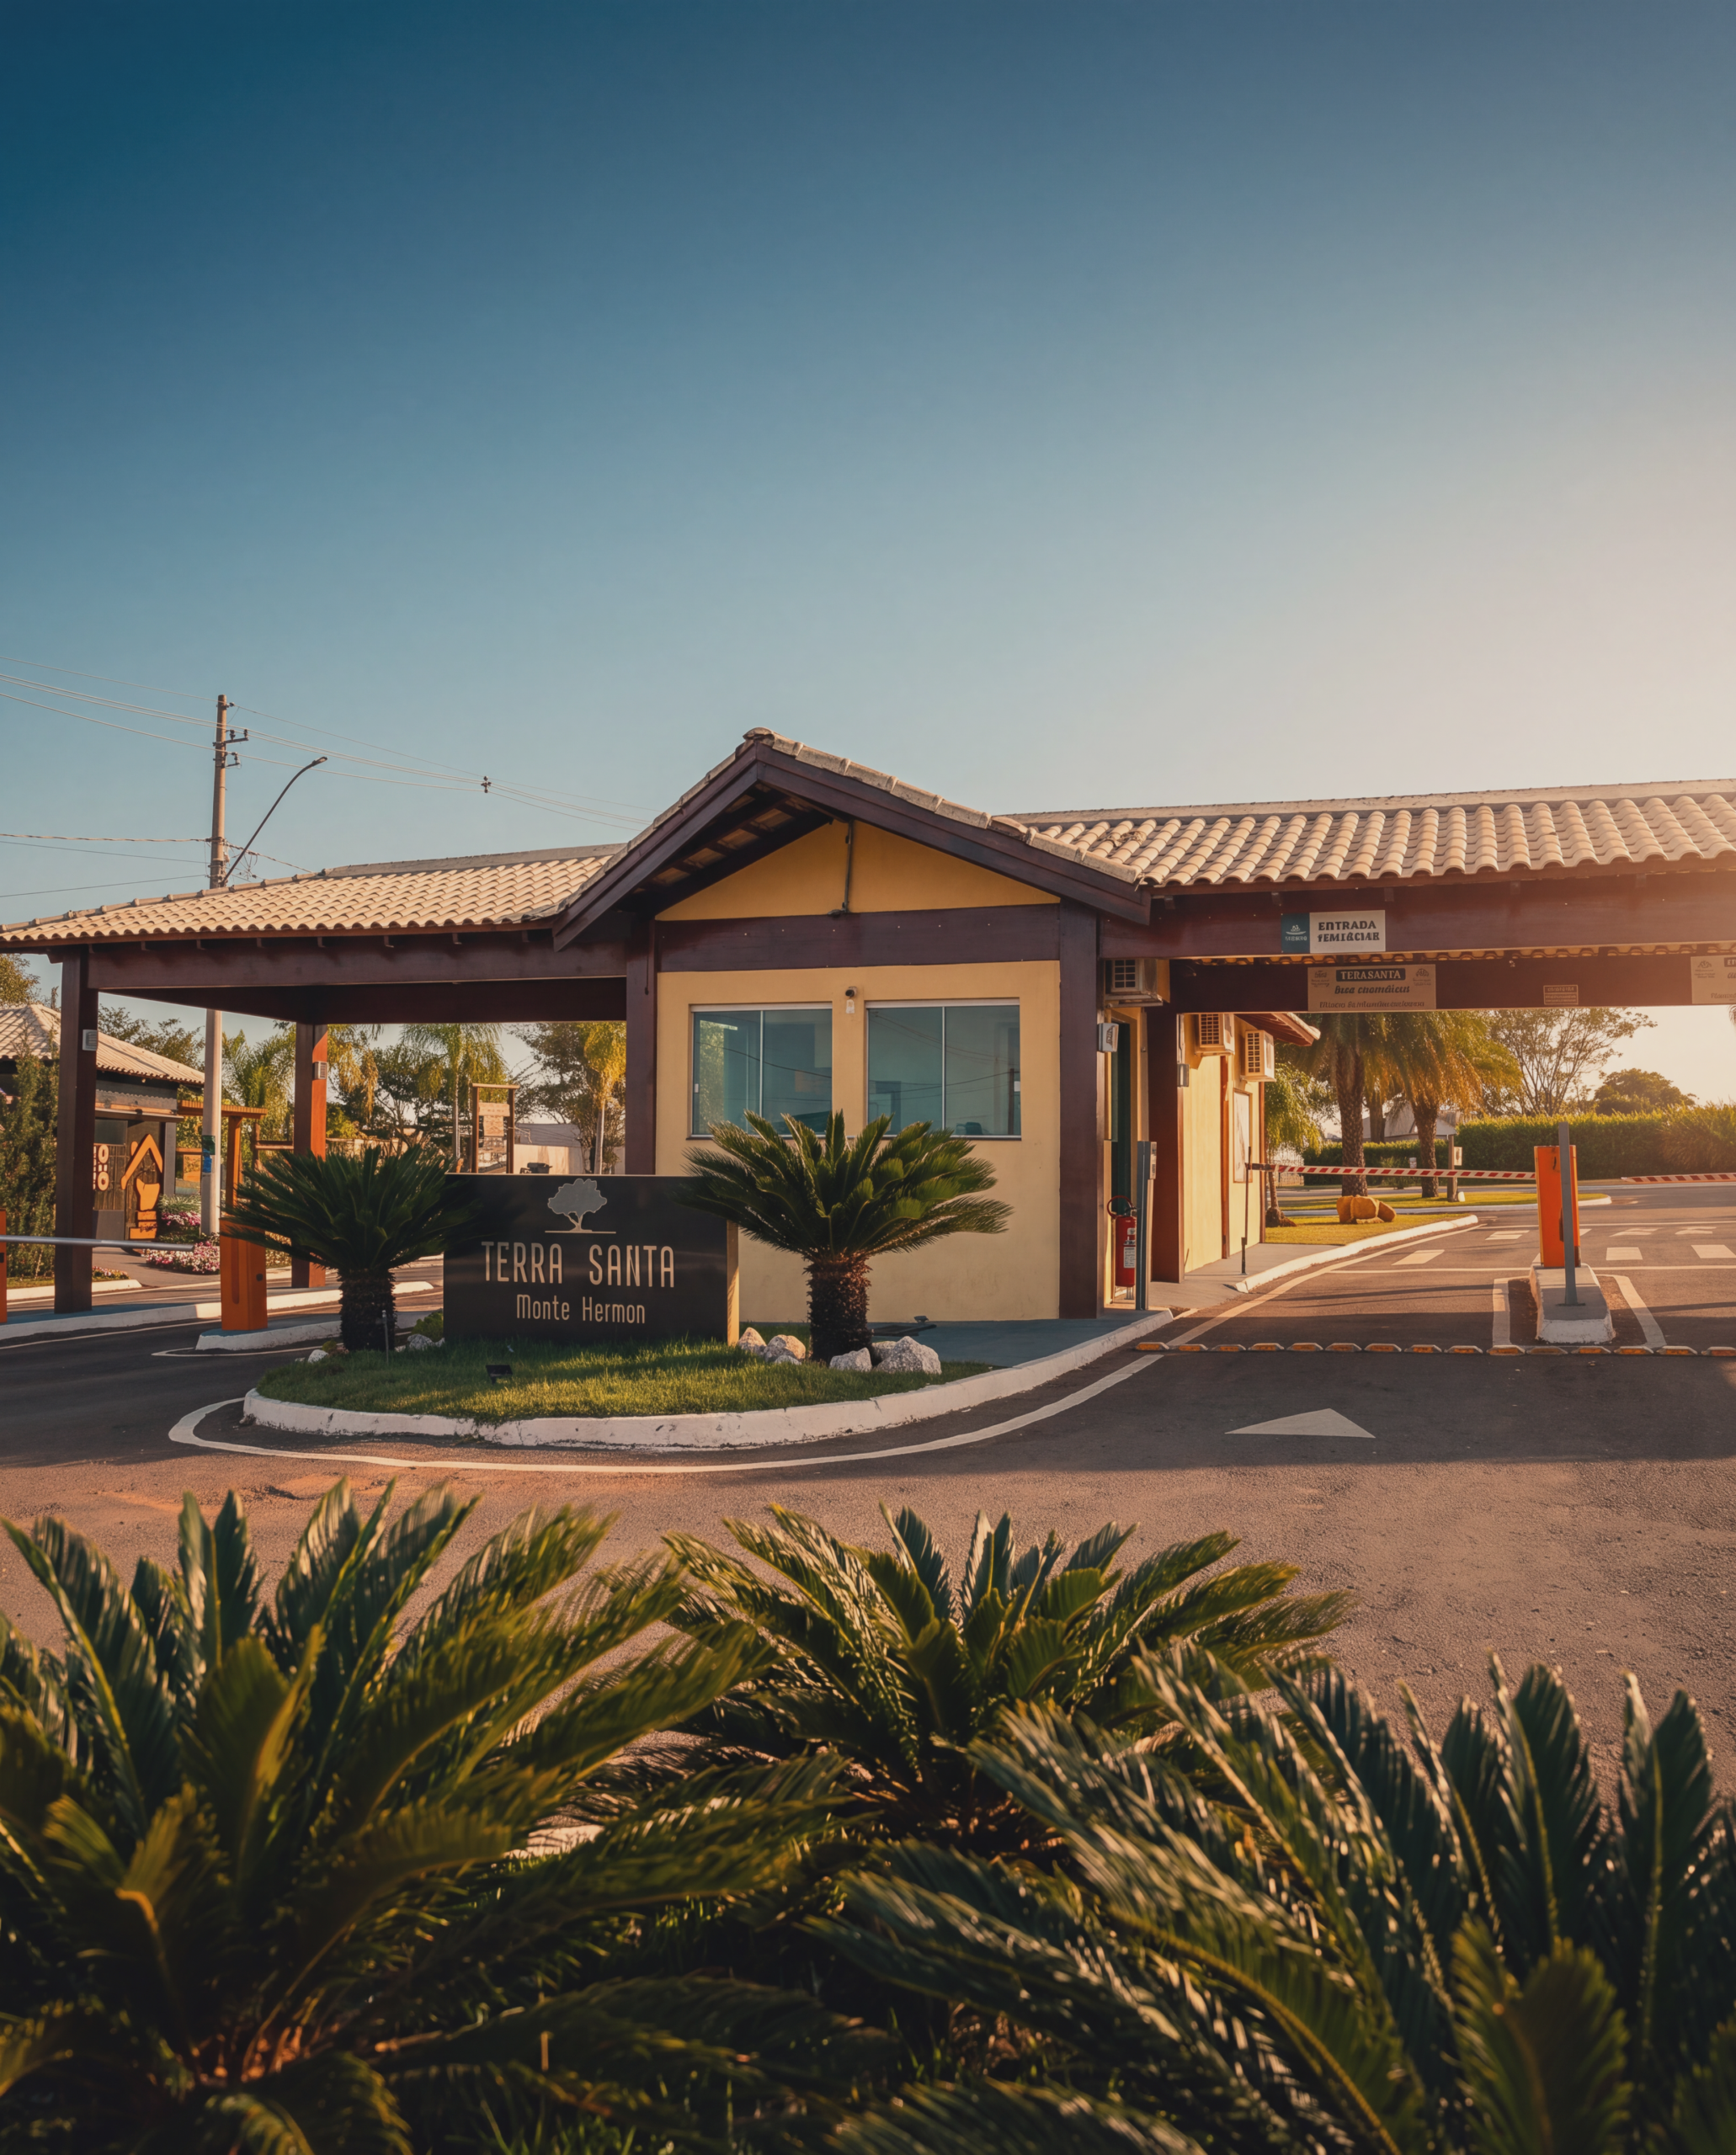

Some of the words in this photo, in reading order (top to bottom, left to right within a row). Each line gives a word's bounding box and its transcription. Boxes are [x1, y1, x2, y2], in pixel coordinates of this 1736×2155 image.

[1318, 920, 1377, 931] ENTRADA
[481, 1241, 562, 1285] TERRA
[588, 1243, 674, 1288] SANTA
[516, 1294, 570, 1321] Monte
[582, 1296, 646, 1324] Hermon
